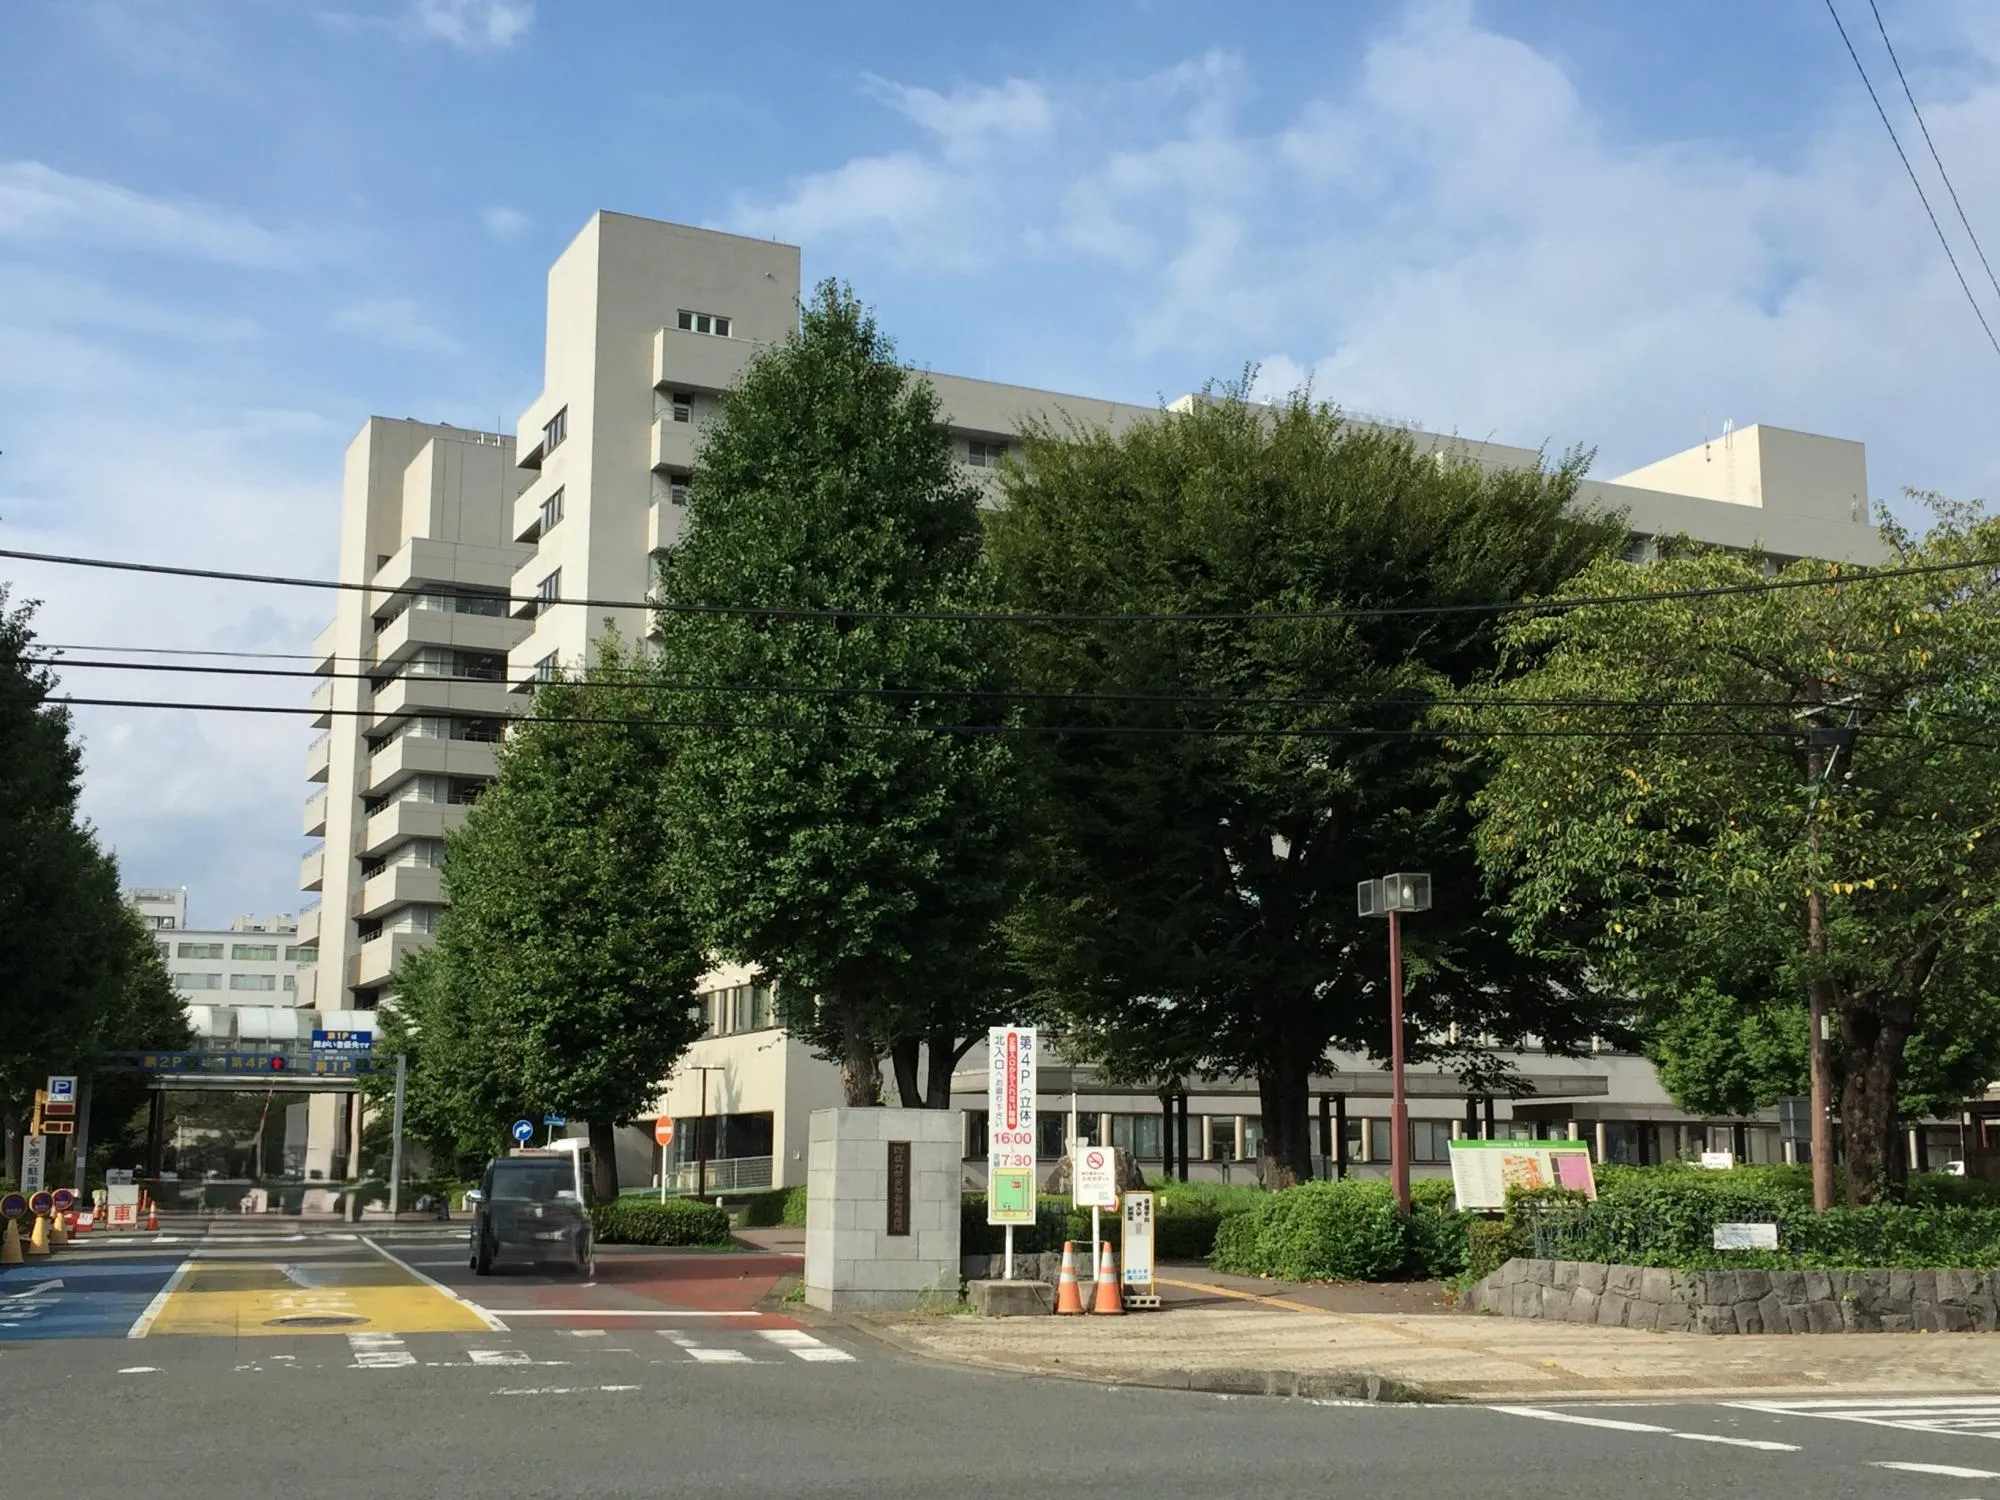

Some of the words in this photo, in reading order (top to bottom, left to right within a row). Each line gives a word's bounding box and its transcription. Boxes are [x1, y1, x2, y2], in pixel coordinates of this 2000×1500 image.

[54, 1081, 69, 1094] P
[994, 1132, 1032, 1145] 16:00
[1002, 1154, 1032, 1167] 7:30
